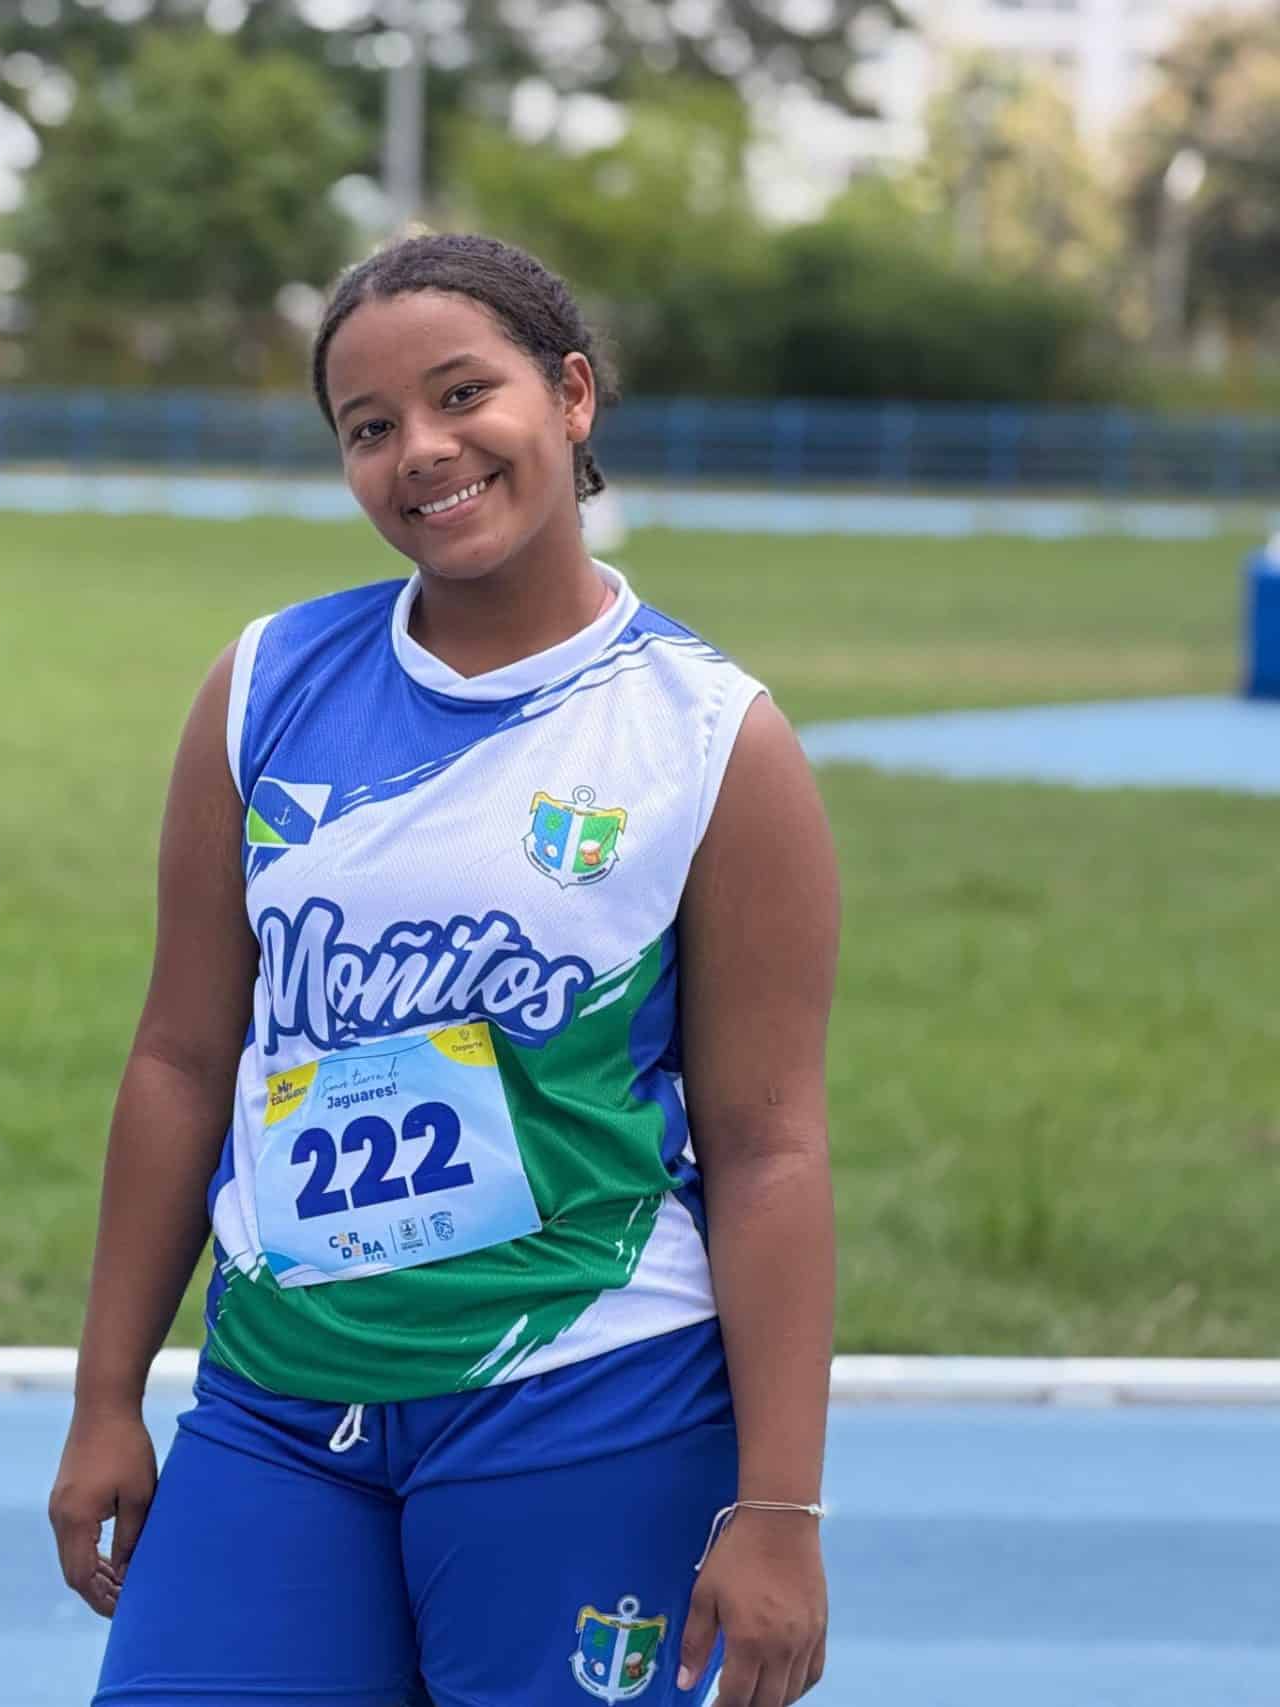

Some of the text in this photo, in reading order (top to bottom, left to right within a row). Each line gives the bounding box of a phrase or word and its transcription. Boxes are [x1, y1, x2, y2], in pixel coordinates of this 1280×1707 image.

[259, 898, 594, 1055] Moñitos
[326, 1081, 398, 1109] Jaguares!
[290, 1101, 474, 1221] 222
